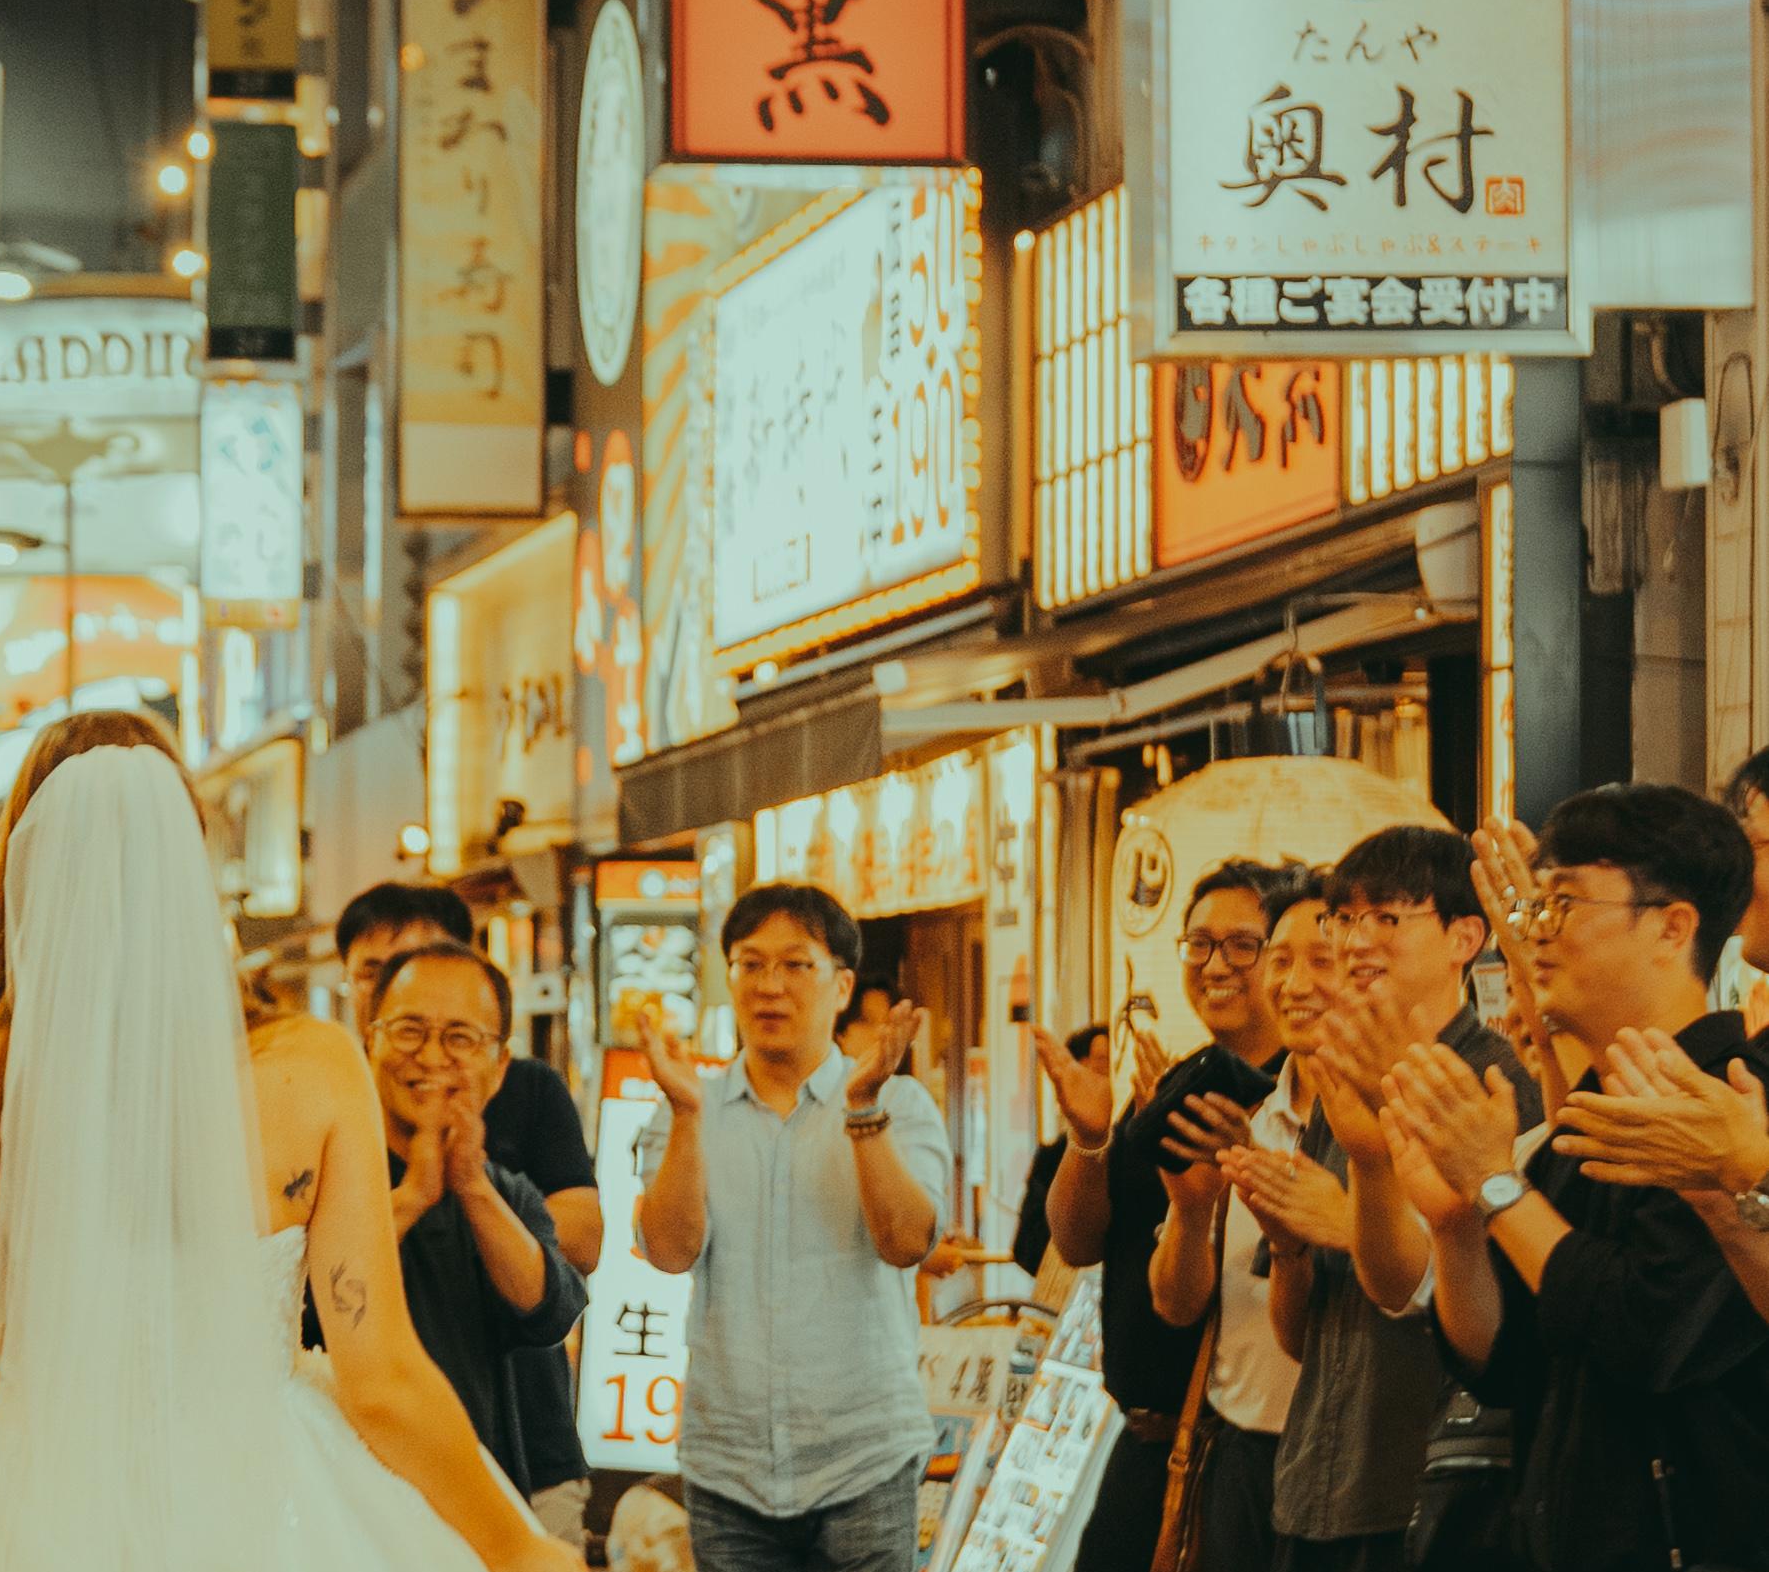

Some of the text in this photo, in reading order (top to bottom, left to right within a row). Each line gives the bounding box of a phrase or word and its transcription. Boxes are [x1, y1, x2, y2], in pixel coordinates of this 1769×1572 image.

[1293, 18, 1440, 63] たんや
[1219, 82, 1494, 215] 奥村
[1182, 276, 1558, 327] 各種ご宴会受付中
[614, 1301, 670, 1359] 生
